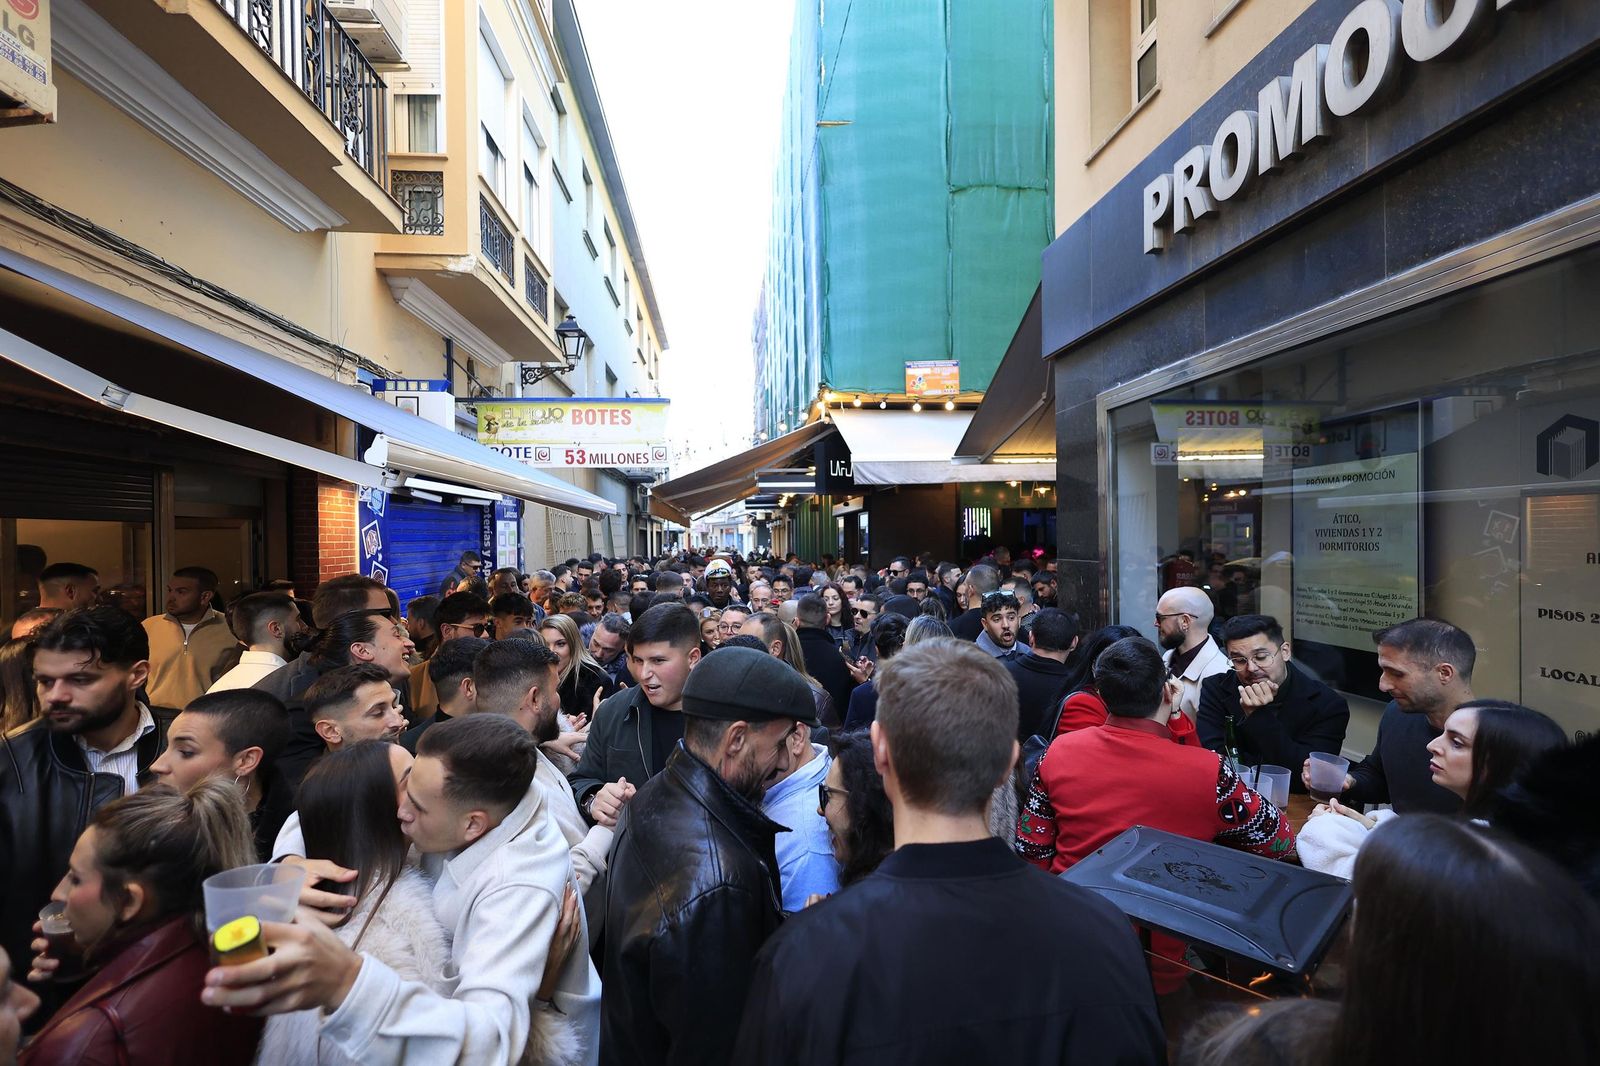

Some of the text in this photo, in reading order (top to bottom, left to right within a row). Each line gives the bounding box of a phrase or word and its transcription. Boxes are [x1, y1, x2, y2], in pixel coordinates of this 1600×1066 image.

[3, 10, 35, 51] LG
[571, 408, 632, 426] BOTES
[491, 446, 650, 465] OTE 53 MILLONES
[1342, 469, 1395, 482] PROMOCIÓN
[483, 503, 493, 547] oterías
[1332, 512, 1361, 525] ÁTICO,
[1315, 527, 1383, 537] VIVIENDAS 1 Y 2
[1319, 542, 1380, 551] DORMITORIOS
[1586, 552, 1600, 565] A
[1537, 607, 1586, 623] PISOS
